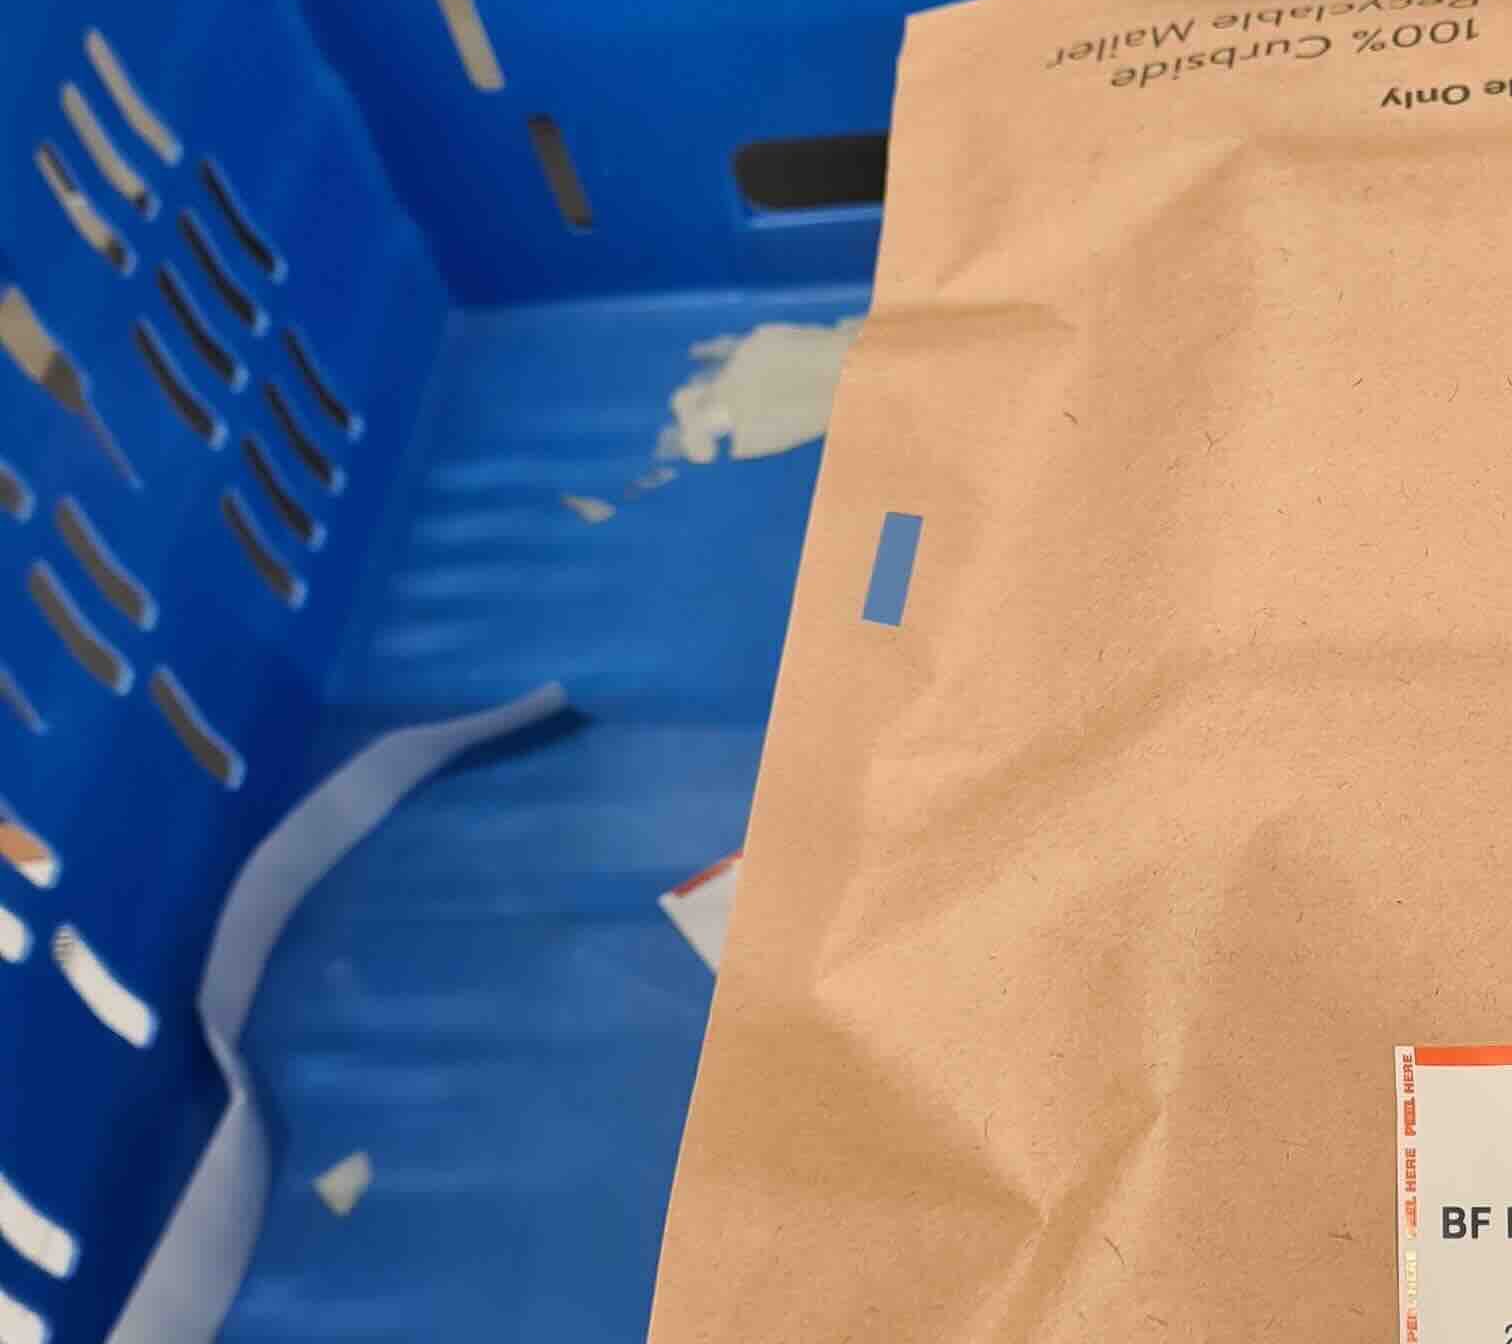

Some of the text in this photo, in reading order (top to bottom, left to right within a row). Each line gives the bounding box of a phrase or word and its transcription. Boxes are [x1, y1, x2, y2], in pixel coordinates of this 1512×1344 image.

[1044, 17, 1196, 70] Mailer
[1110, 17, 1480, 88] 100% Curbside
[1380, 84, 1471, 109] Only
[1402, 1054, 1415, 1093] HERE
[1405, 1147, 1417, 1193] HERE
[1441, 1206, 1492, 1240] BF
